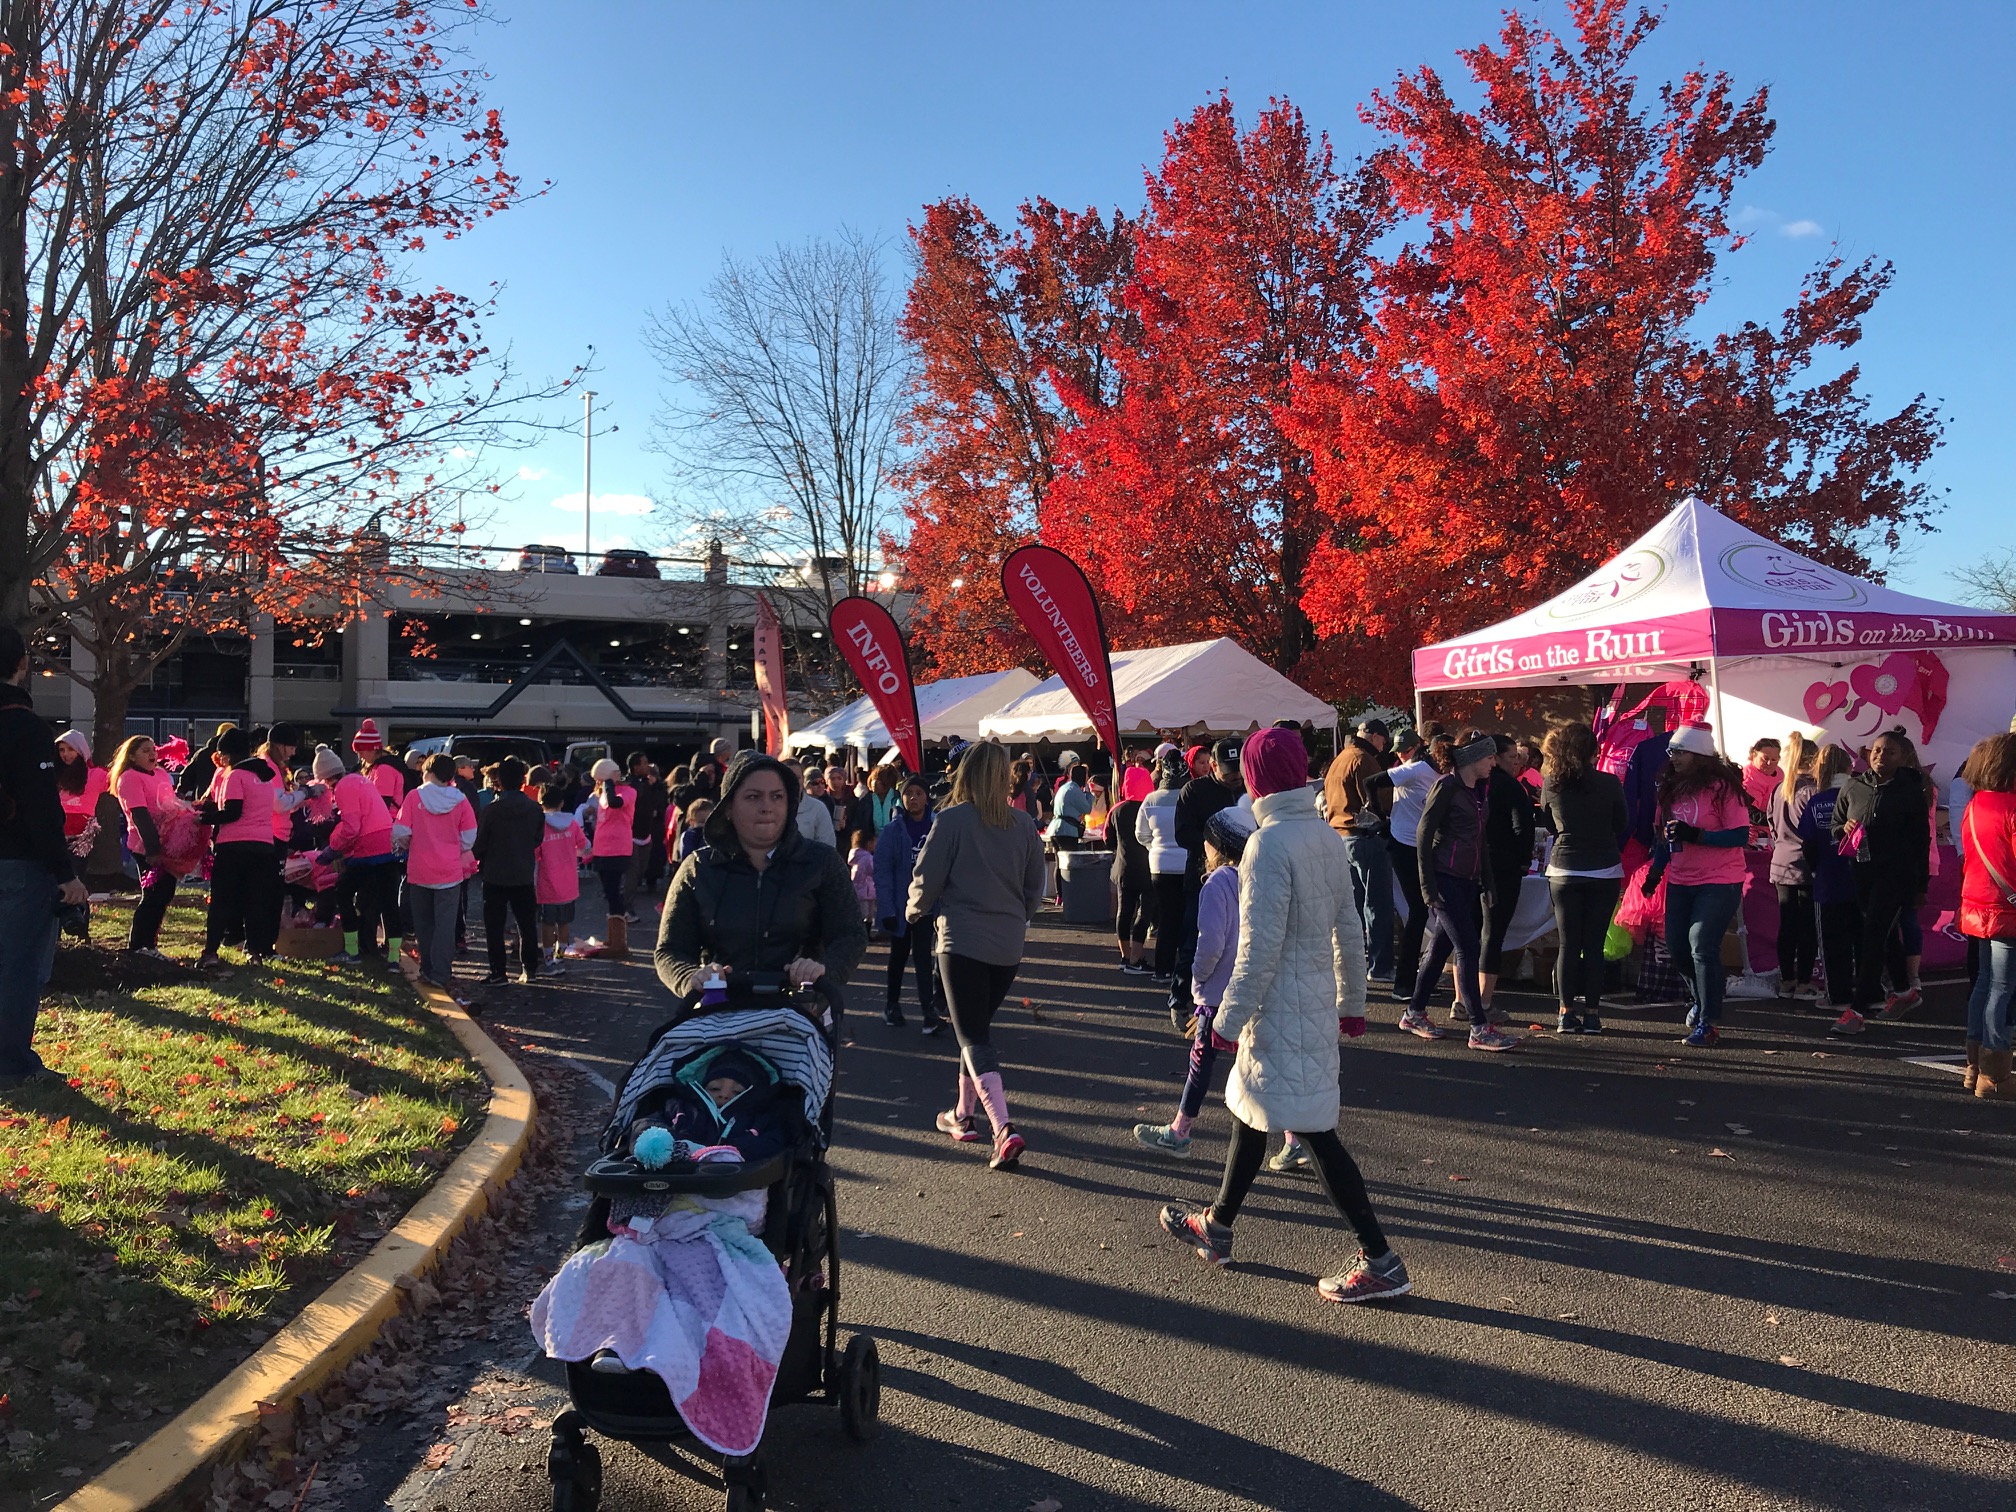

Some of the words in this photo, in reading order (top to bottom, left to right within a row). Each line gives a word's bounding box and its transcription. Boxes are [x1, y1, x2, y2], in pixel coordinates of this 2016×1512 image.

[1764, 577, 1811, 587] Girls
[1018, 562, 1099, 688] VOLUNTEERS
[1761, 612, 1856, 647] Girls
[1858, 632, 1886, 645] on
[1891, 622, 1926, 643] the
[845, 619, 901, 695] INFO
[1442, 644, 1515, 680] Girls
[1518, 652, 1543, 671] on
[1545, 644, 1580, 669] the
[1584, 629, 1666, 663] Run
